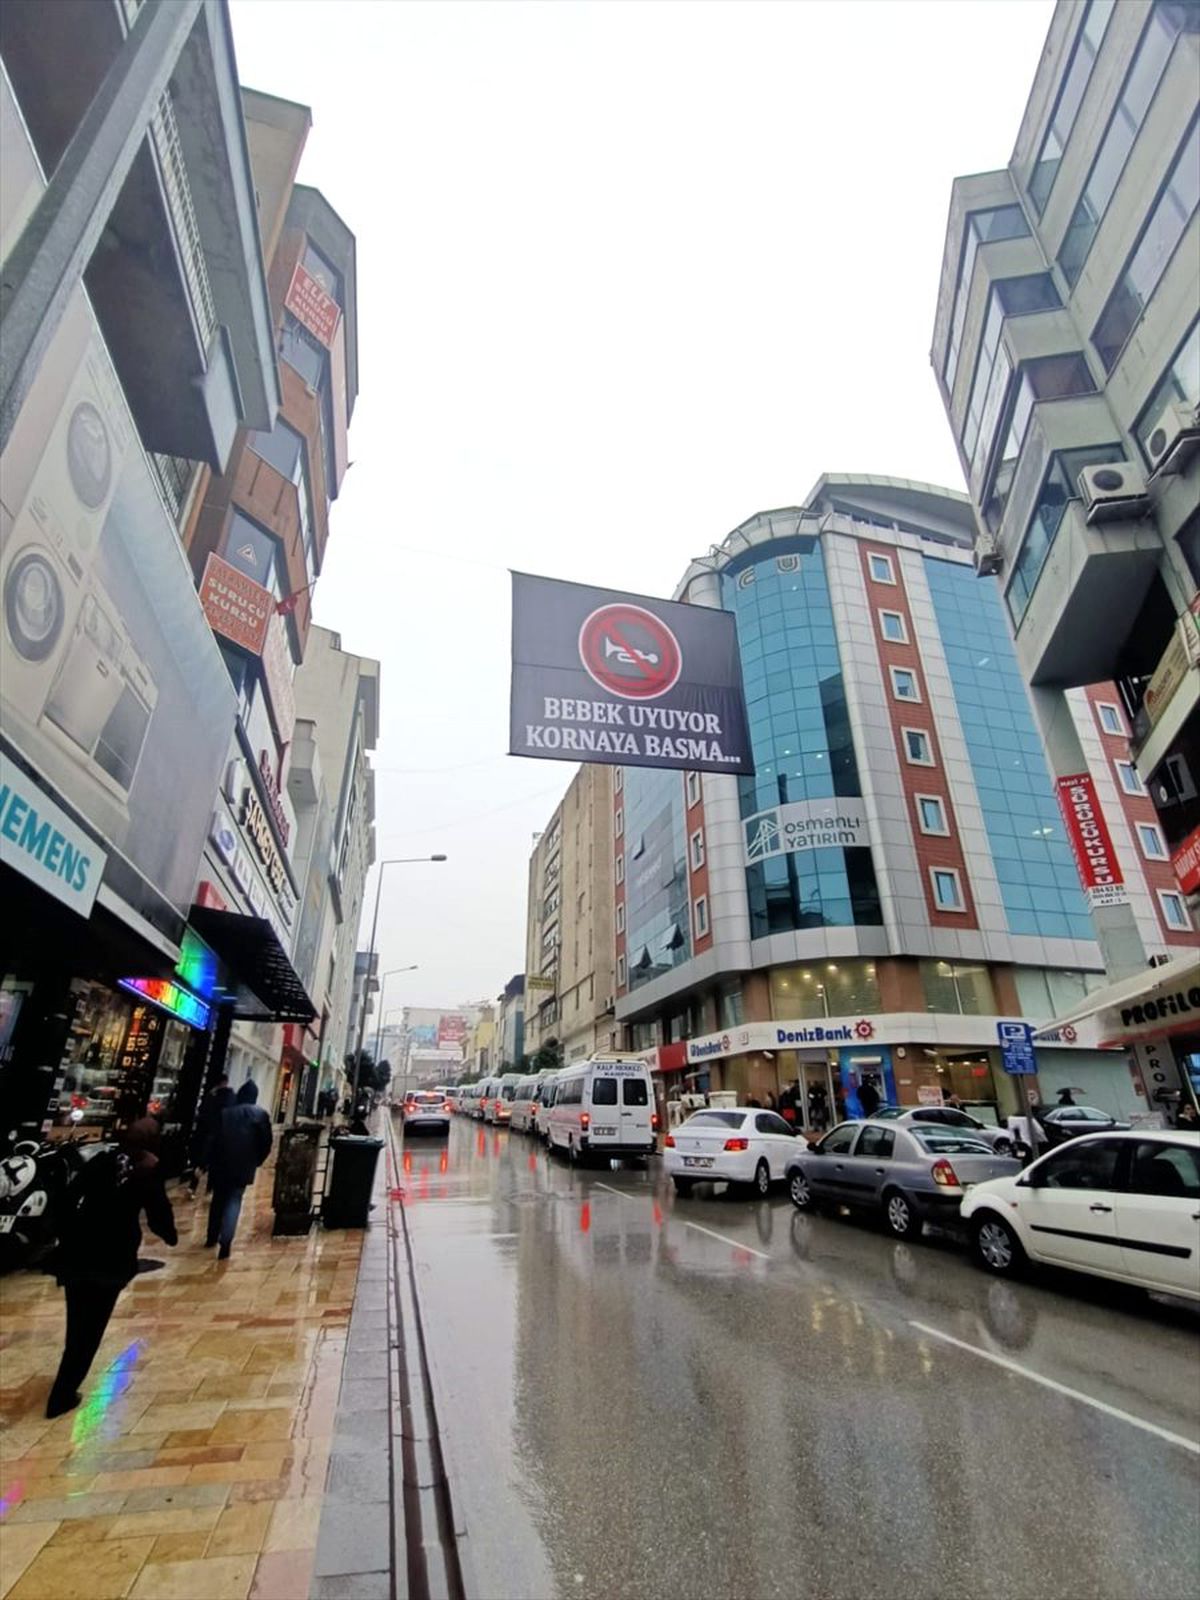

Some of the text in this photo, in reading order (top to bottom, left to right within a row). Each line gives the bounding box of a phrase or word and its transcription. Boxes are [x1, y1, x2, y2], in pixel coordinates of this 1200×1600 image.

[543, 697, 722, 735] BEBEK UYUYOR
[525, 725, 742, 764] KORNAYA BASMA...
[777, 1024, 853, 1043] DenizBank
